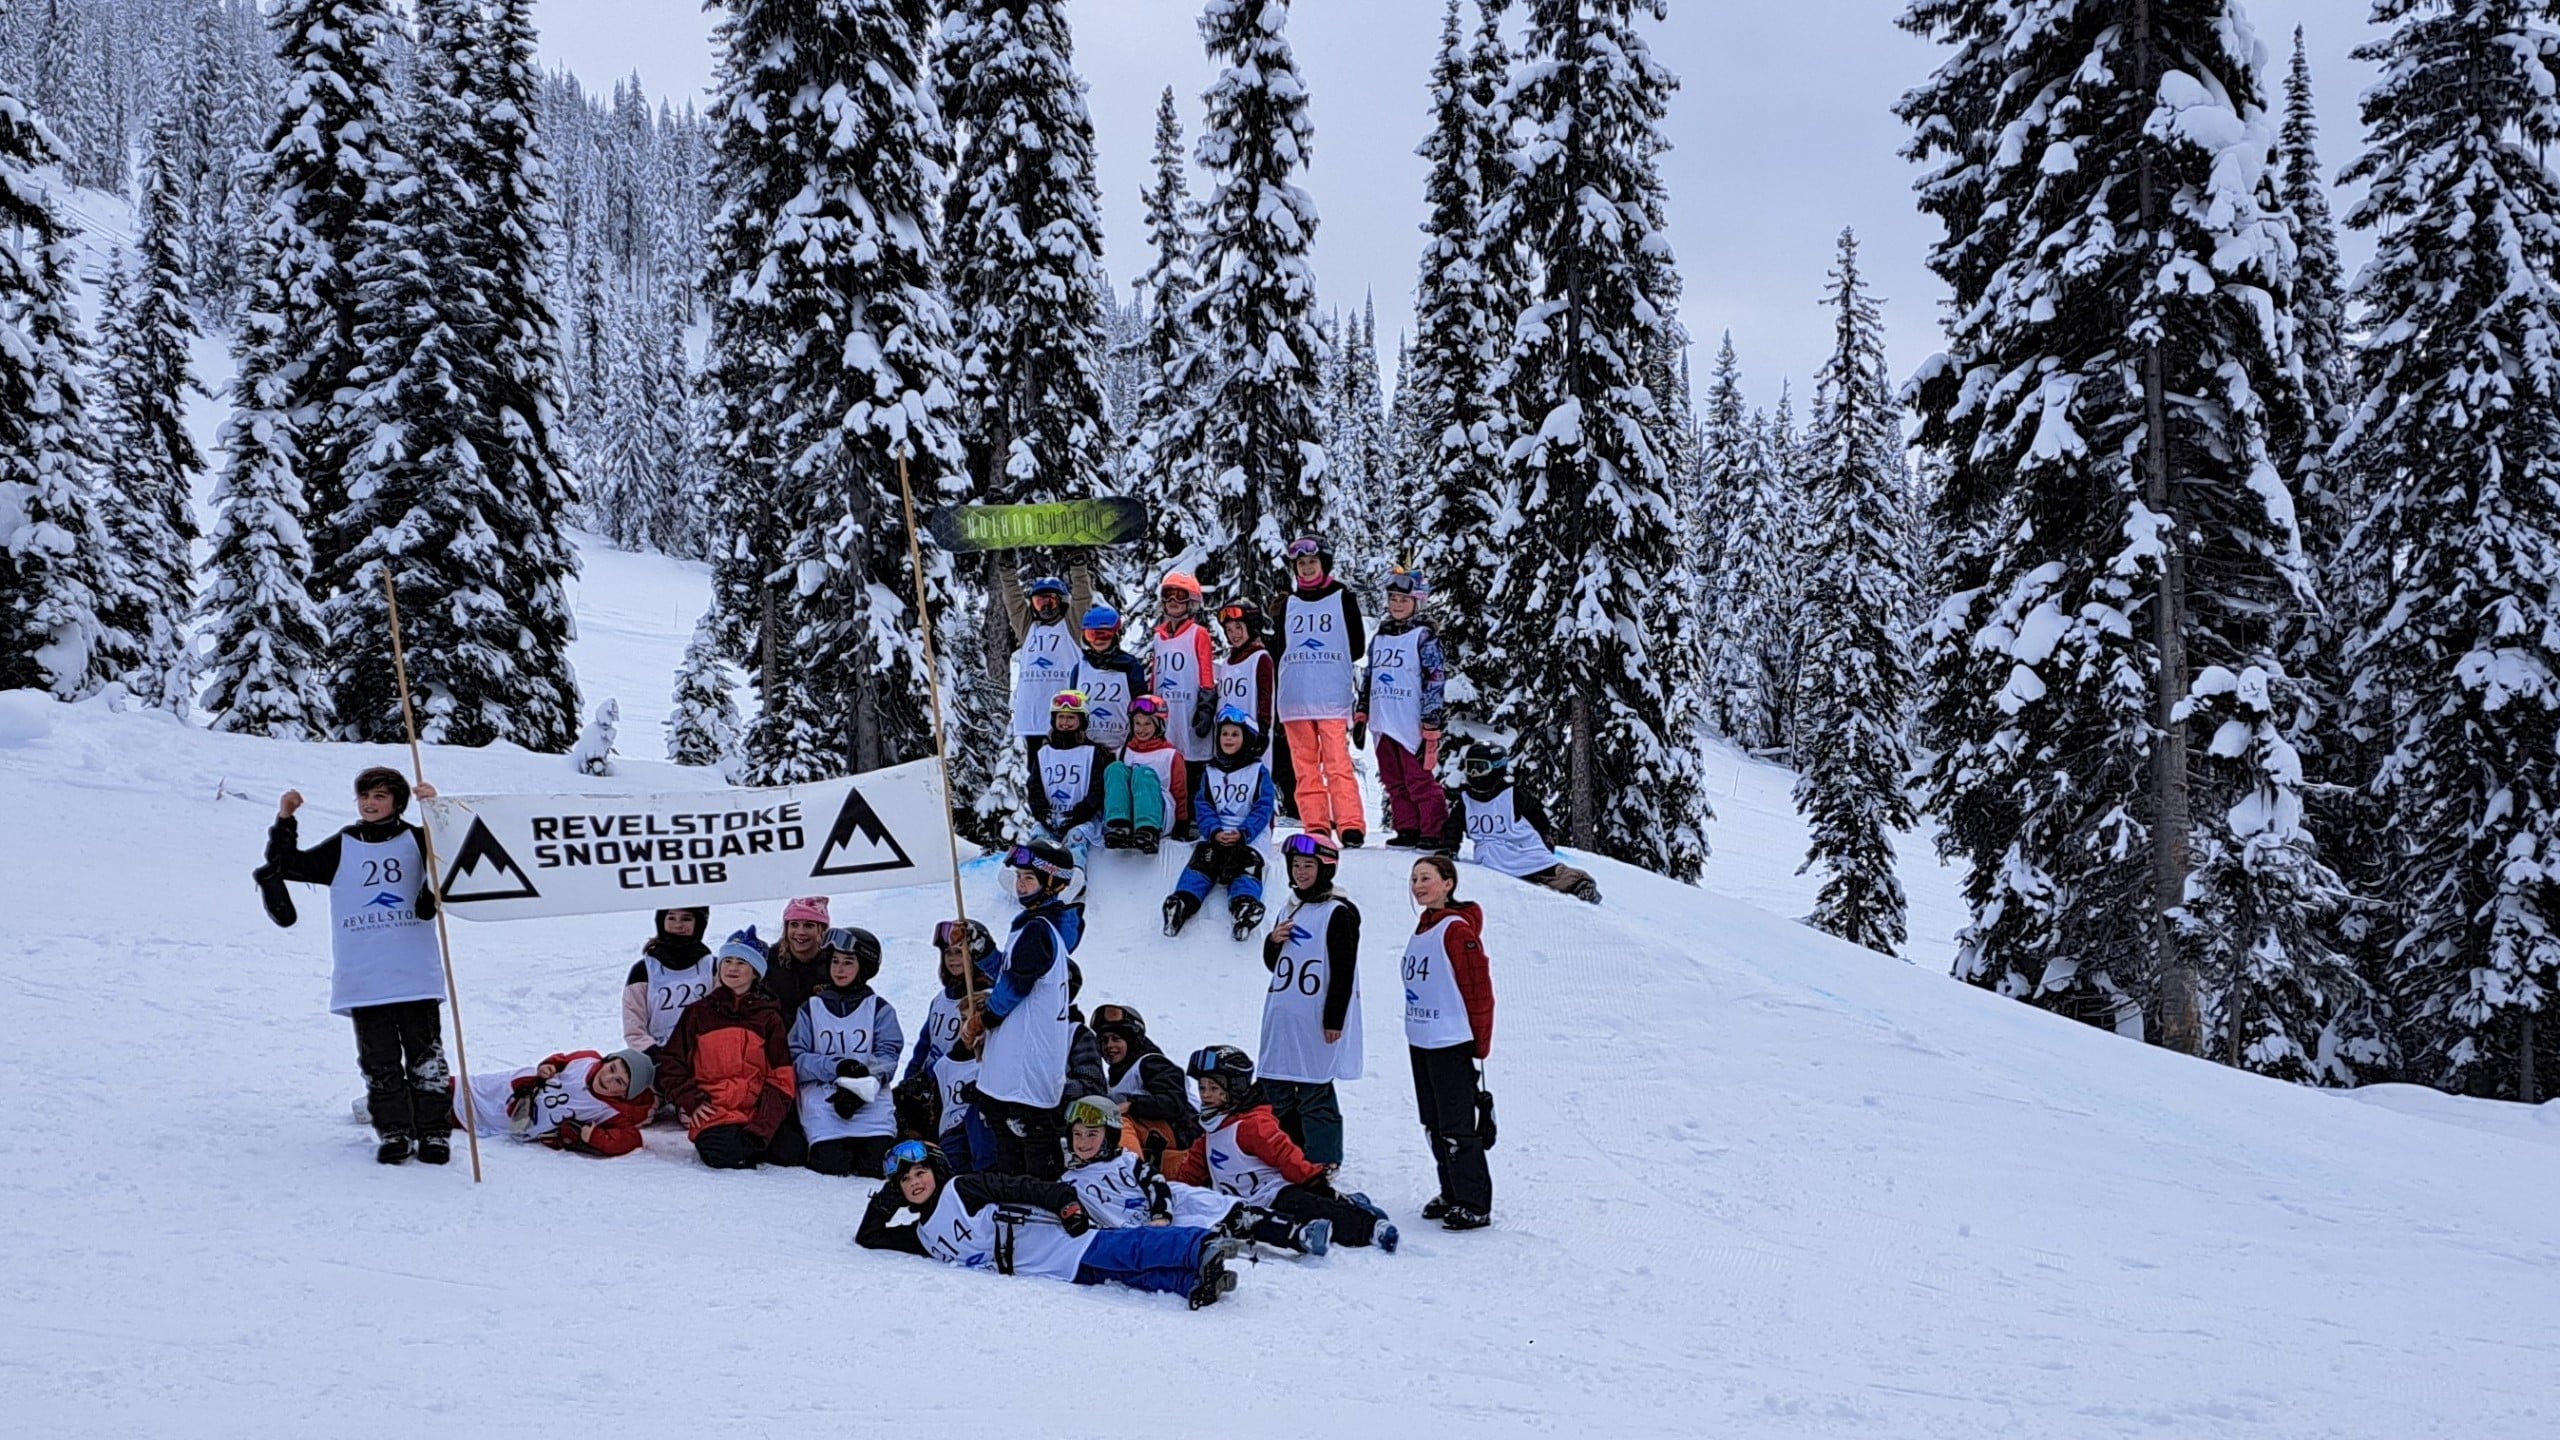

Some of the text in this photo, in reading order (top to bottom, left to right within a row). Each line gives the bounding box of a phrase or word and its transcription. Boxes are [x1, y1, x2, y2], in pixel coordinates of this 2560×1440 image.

[966, 512, 1033, 540] BURTON
[1037, 508, 1104, 535] BURTON
[1292, 613, 1333, 634] 218
[1028, 633, 1060, 653] 217
[1372, 647, 1406, 669] 225
[1081, 681, 1122, 703] 222
[1045, 763, 1081, 787] 295
[1213, 783, 1250, 805] 208
[531, 801, 802, 842] REVELSTOKE
[1468, 814, 1507, 835] 203
[534, 826, 804, 869] SNOWBOARD
[361, 857, 402, 888] 28
[618, 862, 728, 890] CLUB
[343, 909, 419, 929] REVELSTO
[1268, 956, 1323, 996] 96
[658, 983, 708, 1011] 223
[819, 1028, 869, 1057] 212
[543, 1082, 576, 1127] 283
[1085, 1166, 1138, 1205] 216
[931, 1218, 973, 1264] 214
